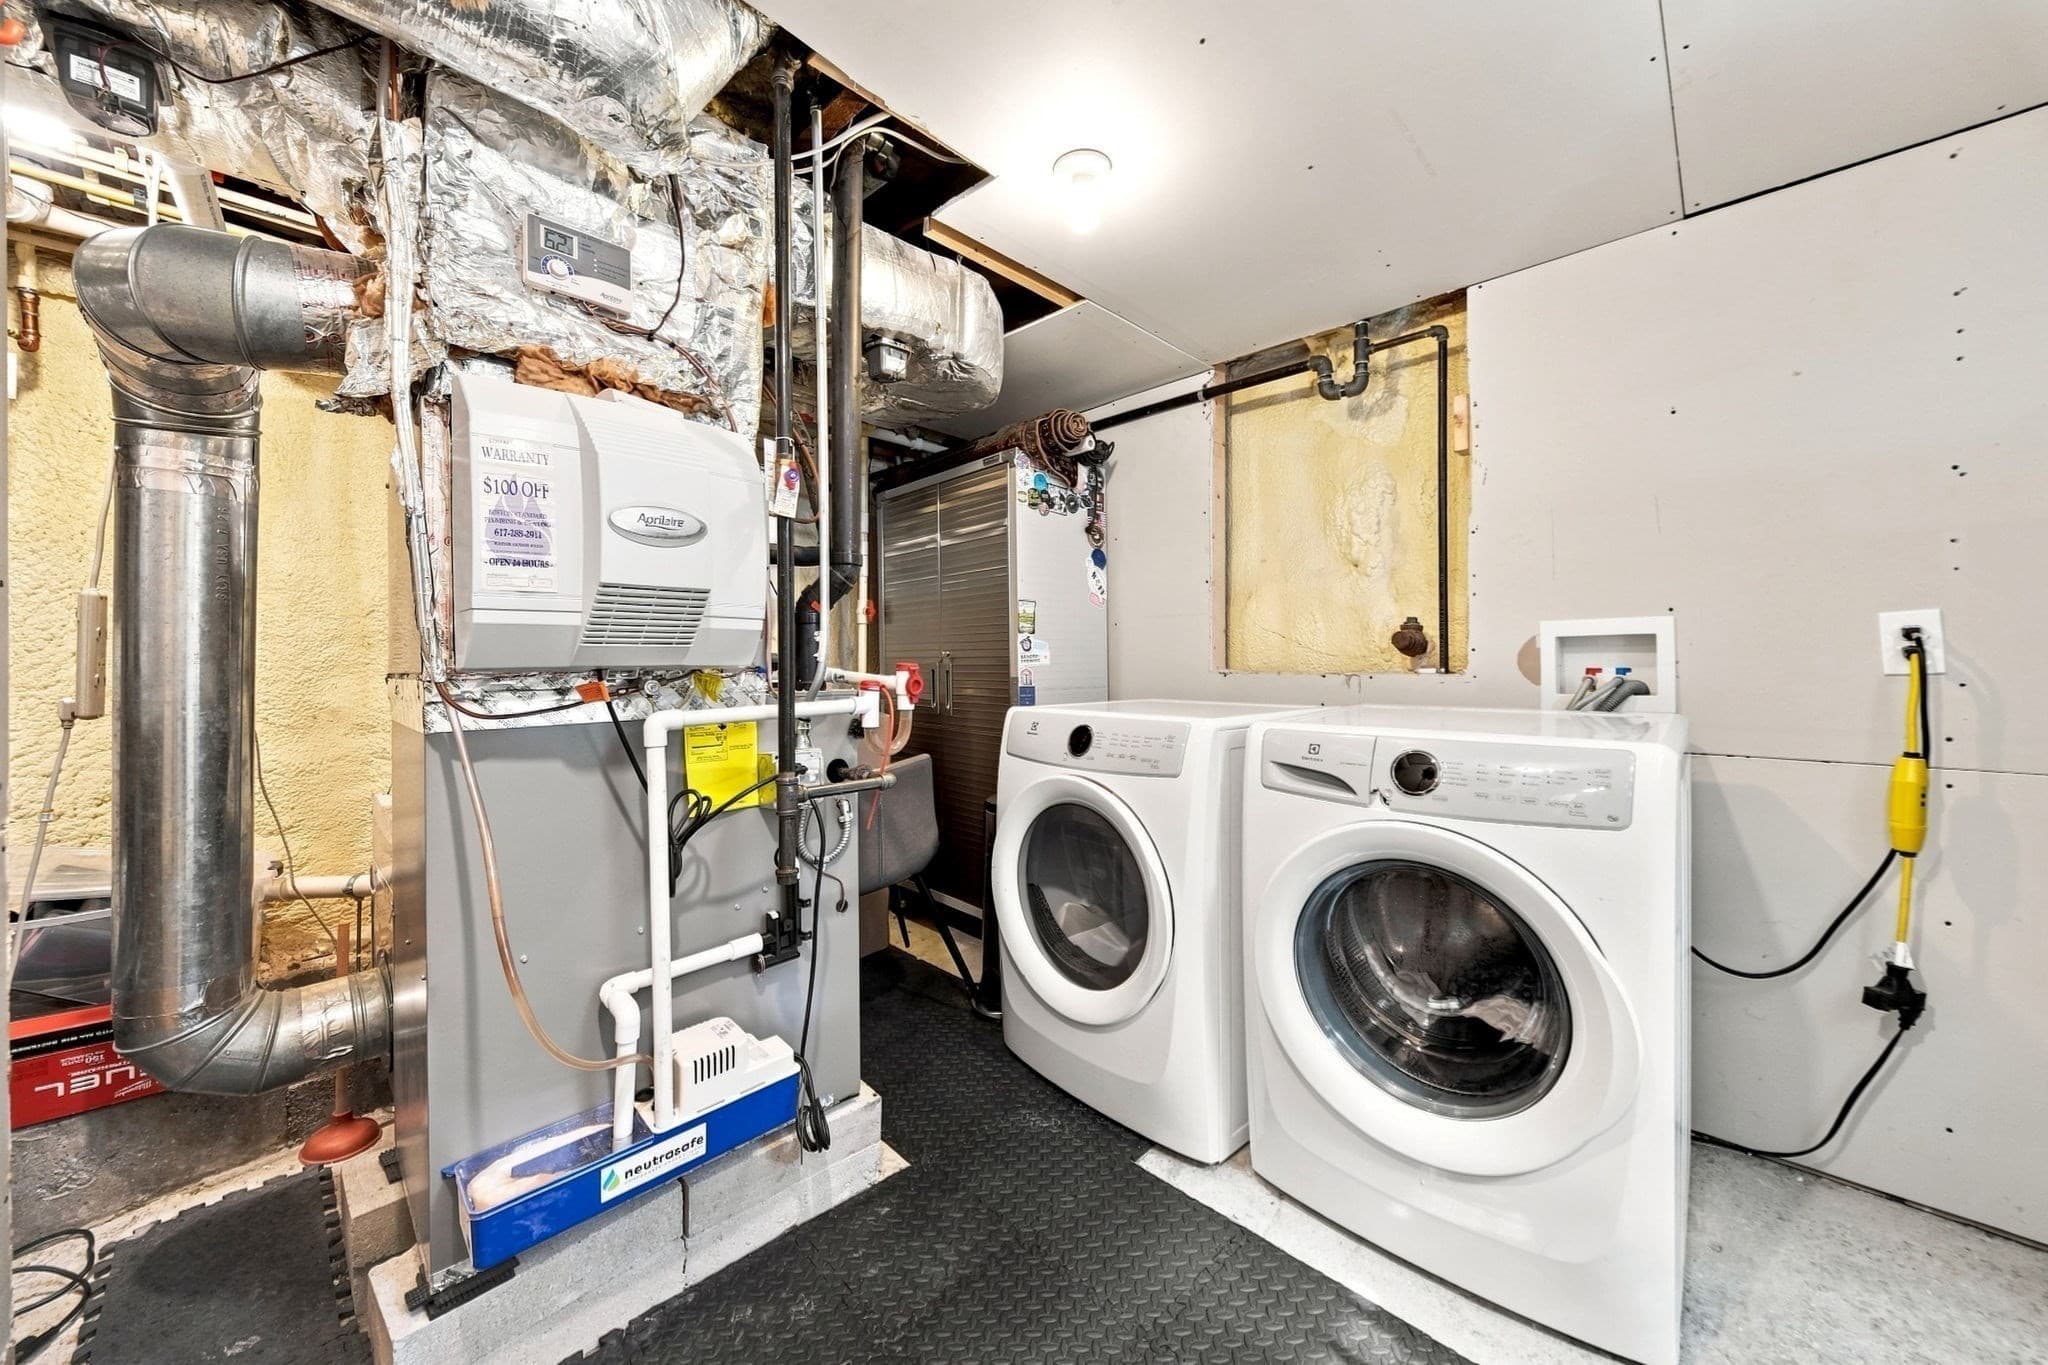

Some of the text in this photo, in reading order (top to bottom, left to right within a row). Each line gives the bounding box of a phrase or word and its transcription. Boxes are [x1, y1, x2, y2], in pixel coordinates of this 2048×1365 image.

[481, 446, 550, 466] WARRANTY
[483, 475, 549, 499] $100 OFF
[637, 513, 685, 528] Aprilaire
[521, 559, 550, 568] HOURS
[624, 1136, 704, 1179] neutrasafe
